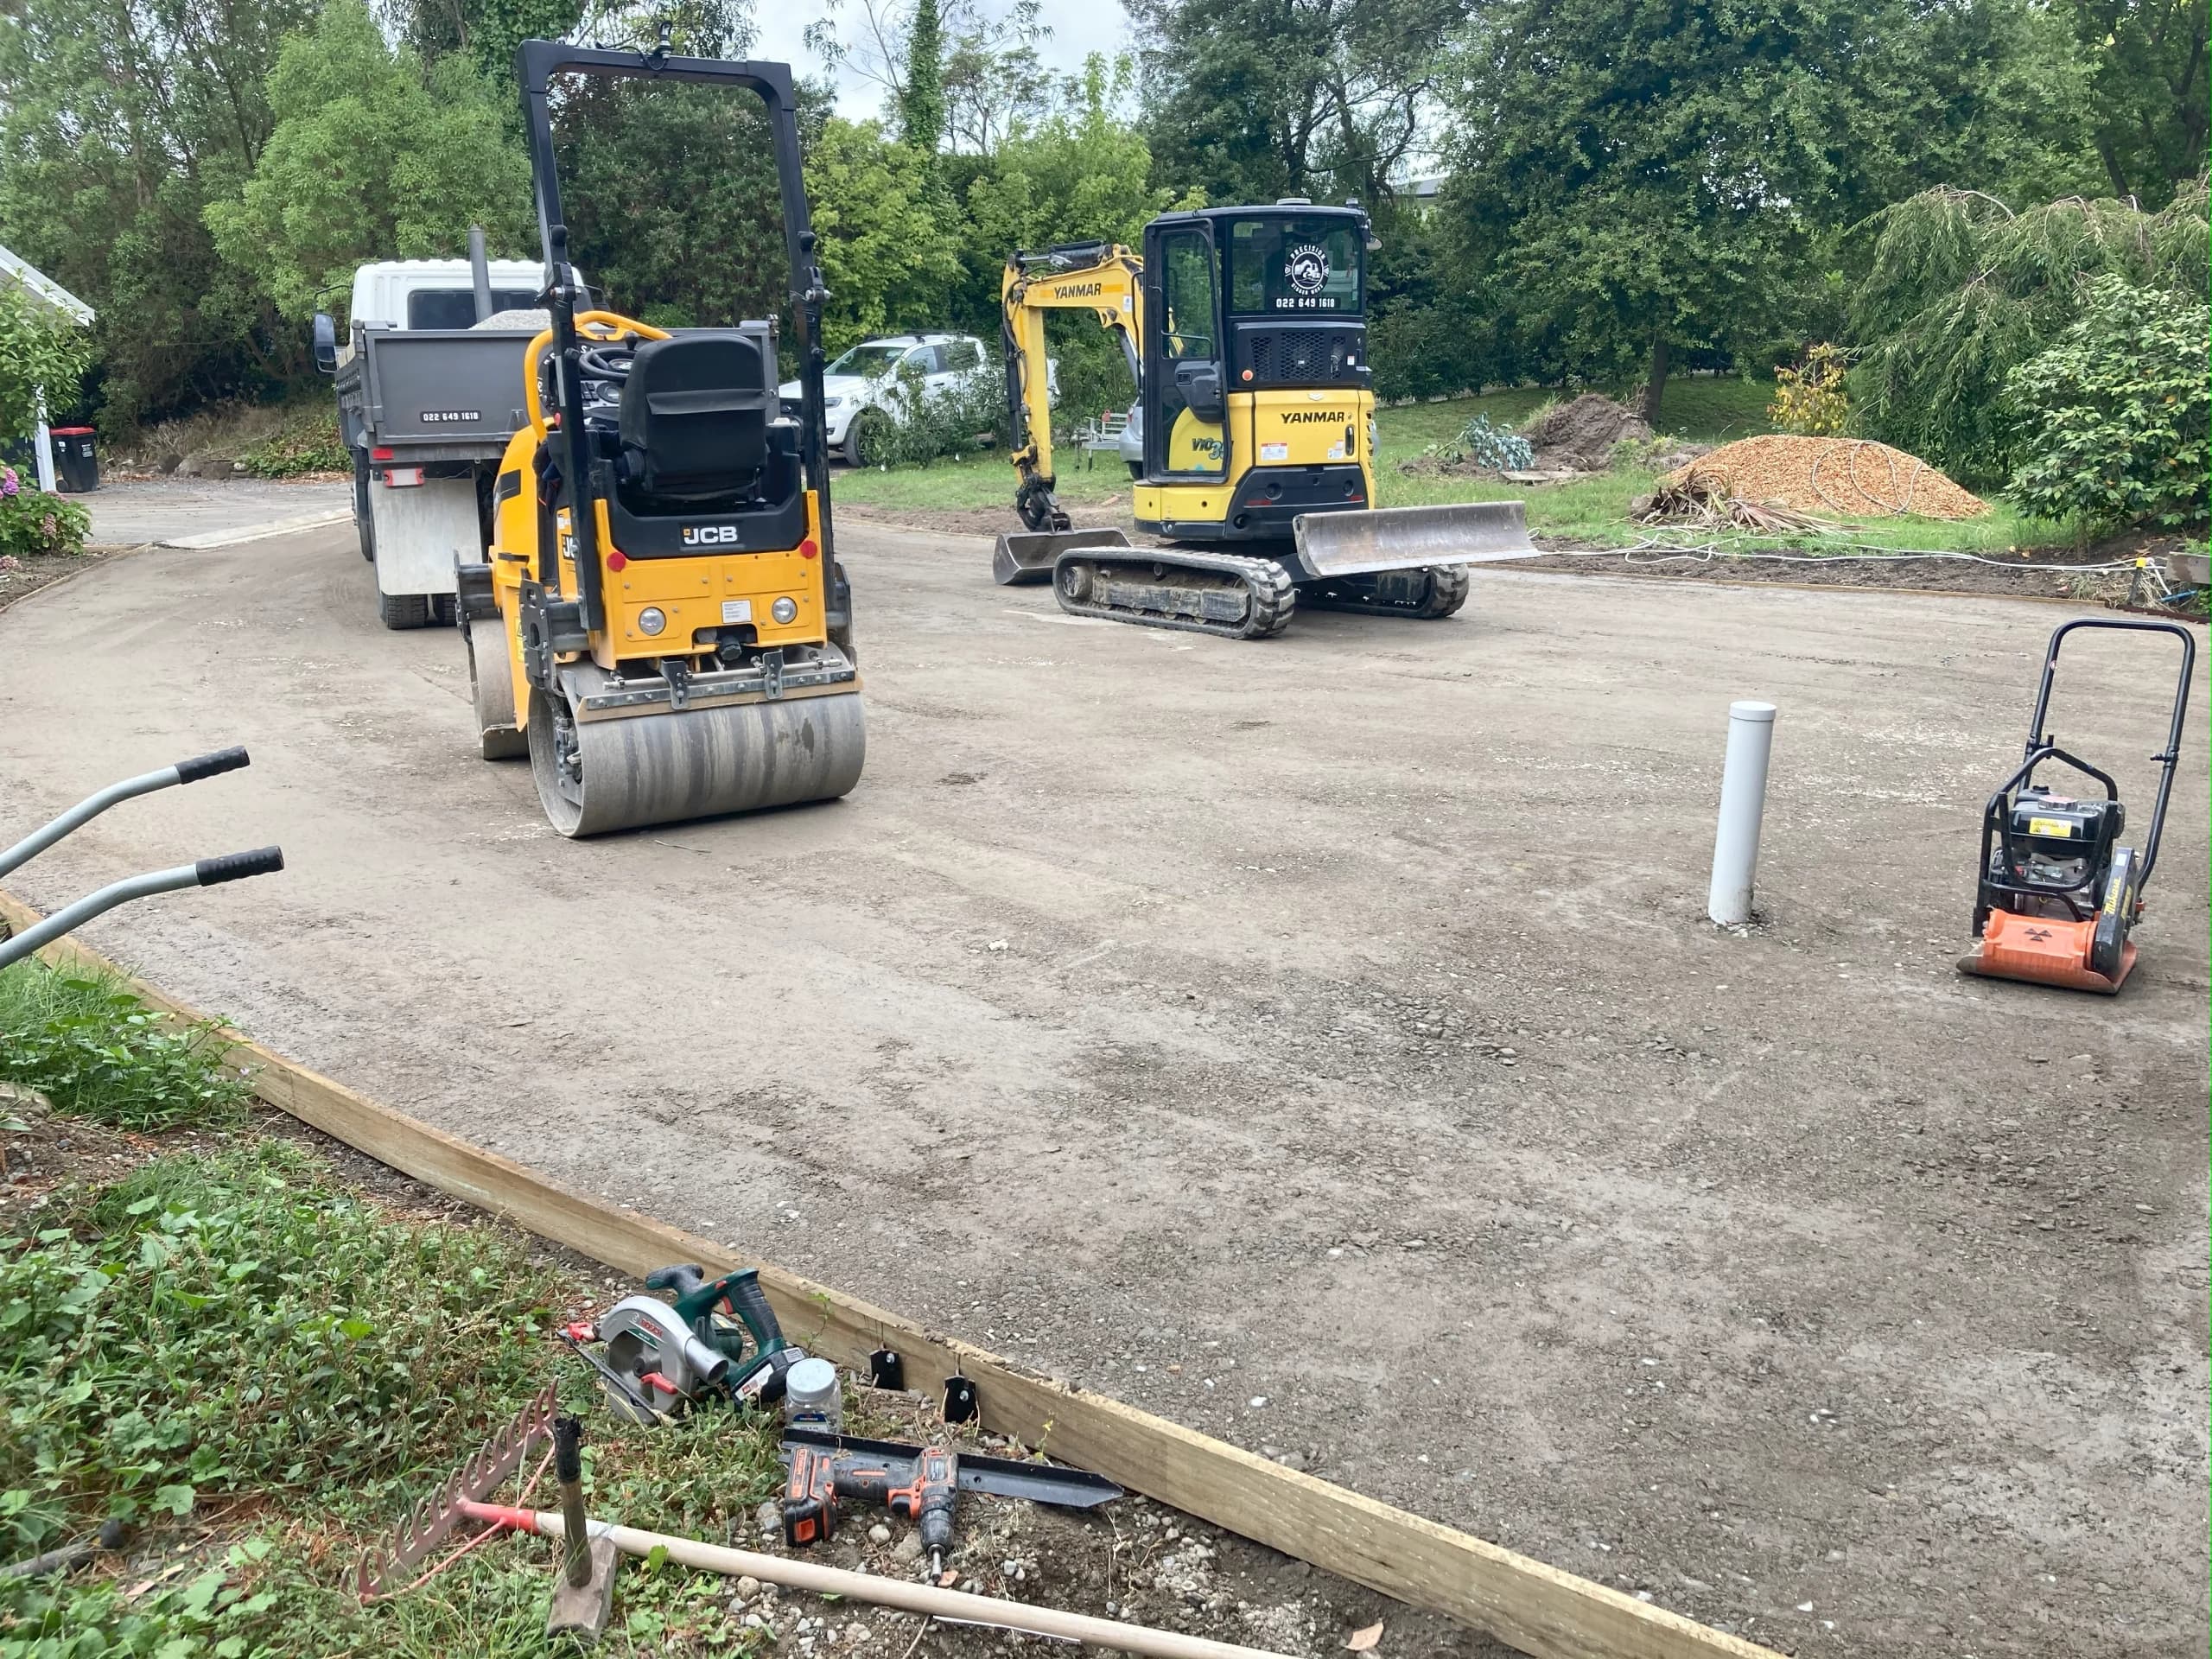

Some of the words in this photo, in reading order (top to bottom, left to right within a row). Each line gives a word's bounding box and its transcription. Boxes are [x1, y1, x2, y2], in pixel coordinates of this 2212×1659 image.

[1290, 245, 1326, 259] PRECISION
[1054, 283, 1102, 300] YANMAR
[1276, 298, 1294, 308] 022
[1298, 298, 1316, 308] 649
[1319, 298, 1335, 308] 1618
[423, 413, 440, 422] 022
[442, 412, 459, 421] 649
[1281, 411, 1344, 424] YANMAR
[683, 526, 738, 544] JCB
[640, 1318, 664, 1338] BOSCH
